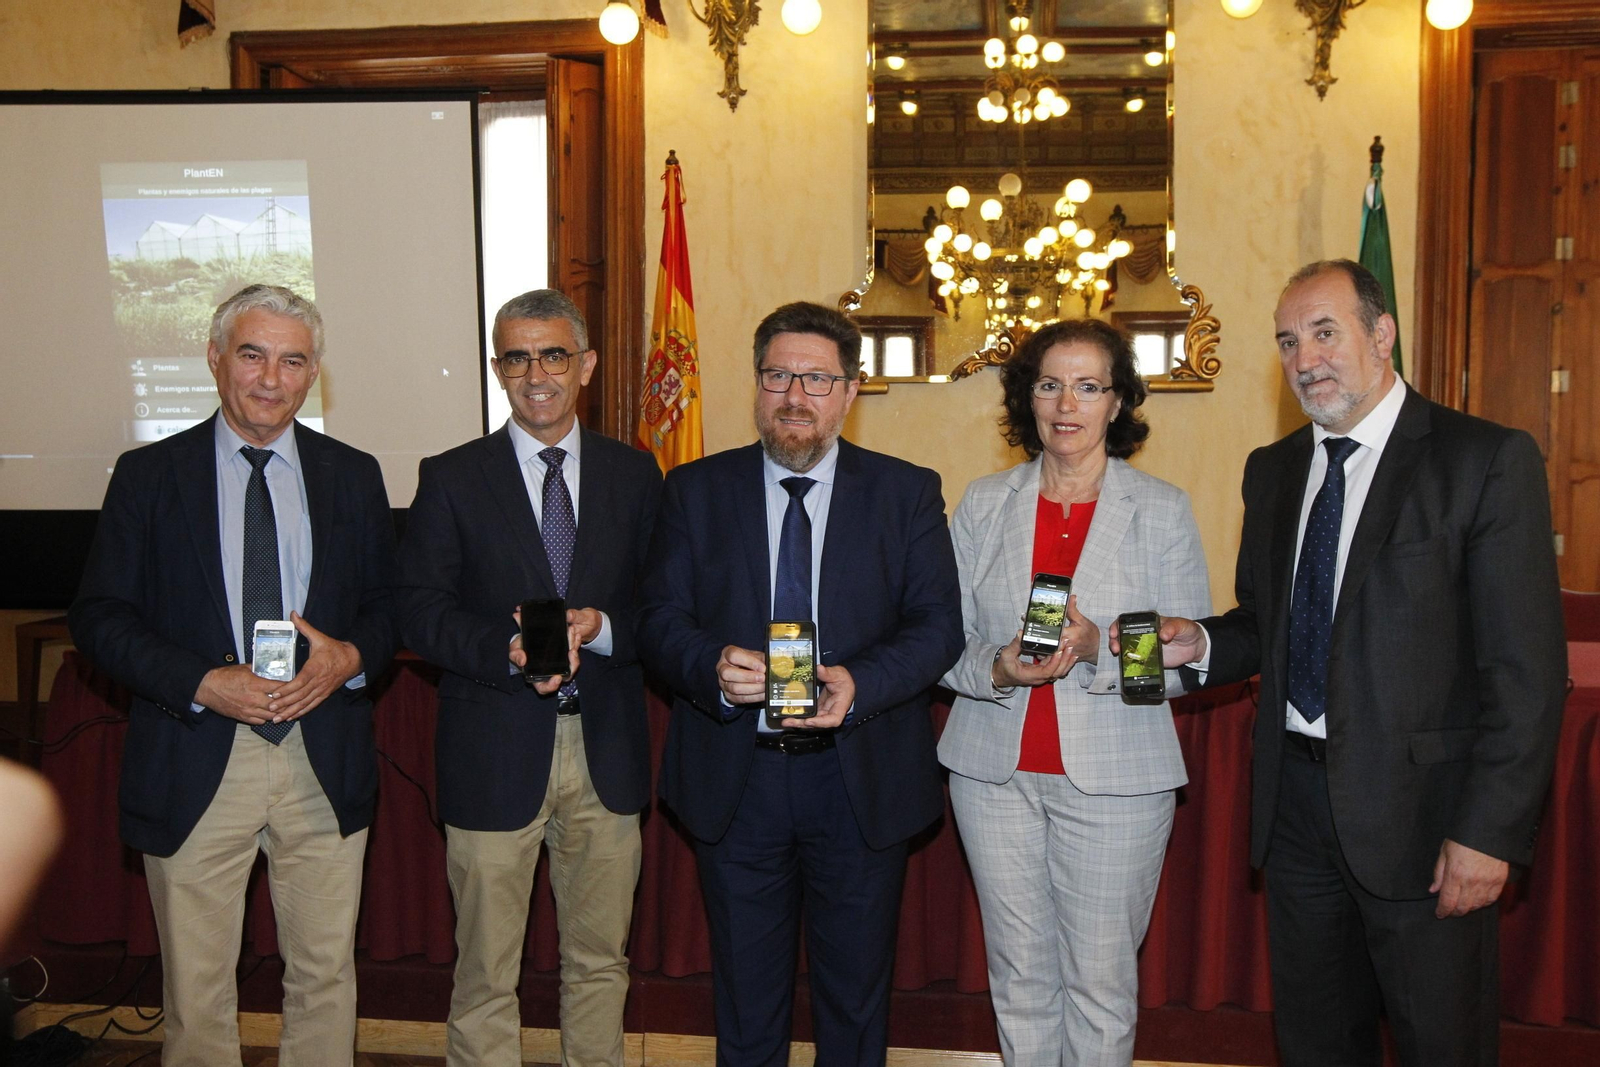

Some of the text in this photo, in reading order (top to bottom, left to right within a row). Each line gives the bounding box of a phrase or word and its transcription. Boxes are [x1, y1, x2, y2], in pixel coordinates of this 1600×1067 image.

[184, 168, 224, 178] PlantEN
[168, 188, 199, 196] enemigos
[251, 186, 272, 194] plagas
[154, 385, 190, 394] Enemigos
